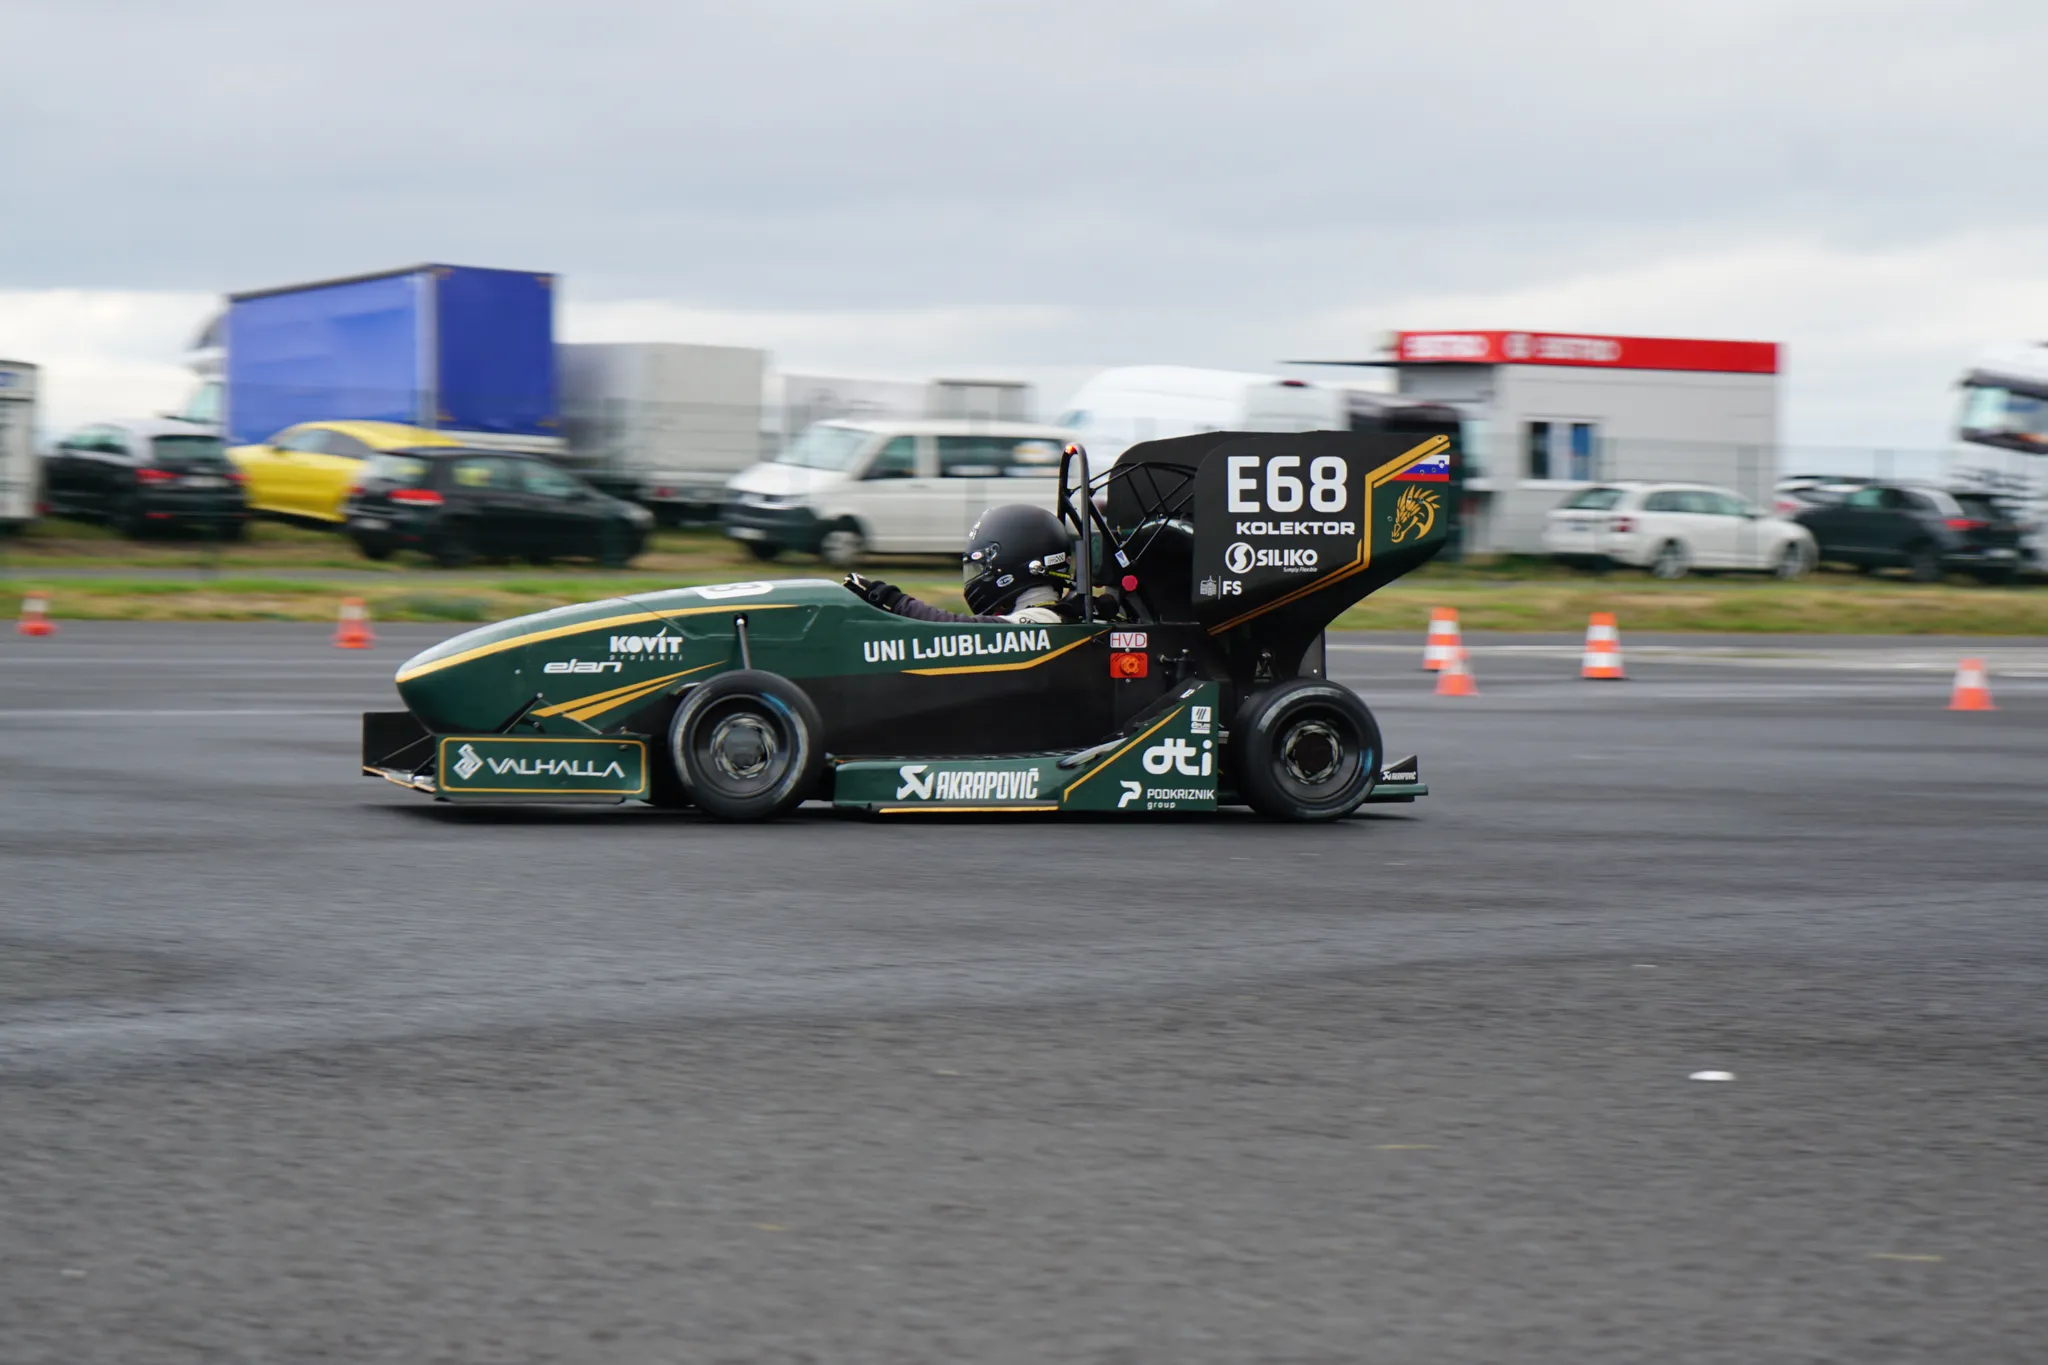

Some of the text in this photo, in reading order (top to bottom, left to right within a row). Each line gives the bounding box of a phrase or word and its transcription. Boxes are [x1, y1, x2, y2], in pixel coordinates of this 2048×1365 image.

[1227, 455, 1348, 513] E68
[1236, 521, 1356, 536] KOLEKTOR
[1256, 549, 1318, 567] SILIKO
[1222, 580, 1242, 596] FS
[609, 631, 684, 654] KOVIT
[863, 629, 1052, 663] UNI LJUBLJANA
[1111, 632, 1147, 647] HVD
[543, 658, 623, 674] elan
[1142, 737, 1213, 776] dti
[487, 757, 626, 779] VALHALLA
[936, 767, 1040, 800] AKRAPOVIČ
[1147, 788, 1215, 800] PODKRIZNIK
[1147, 801, 1176, 810] group
